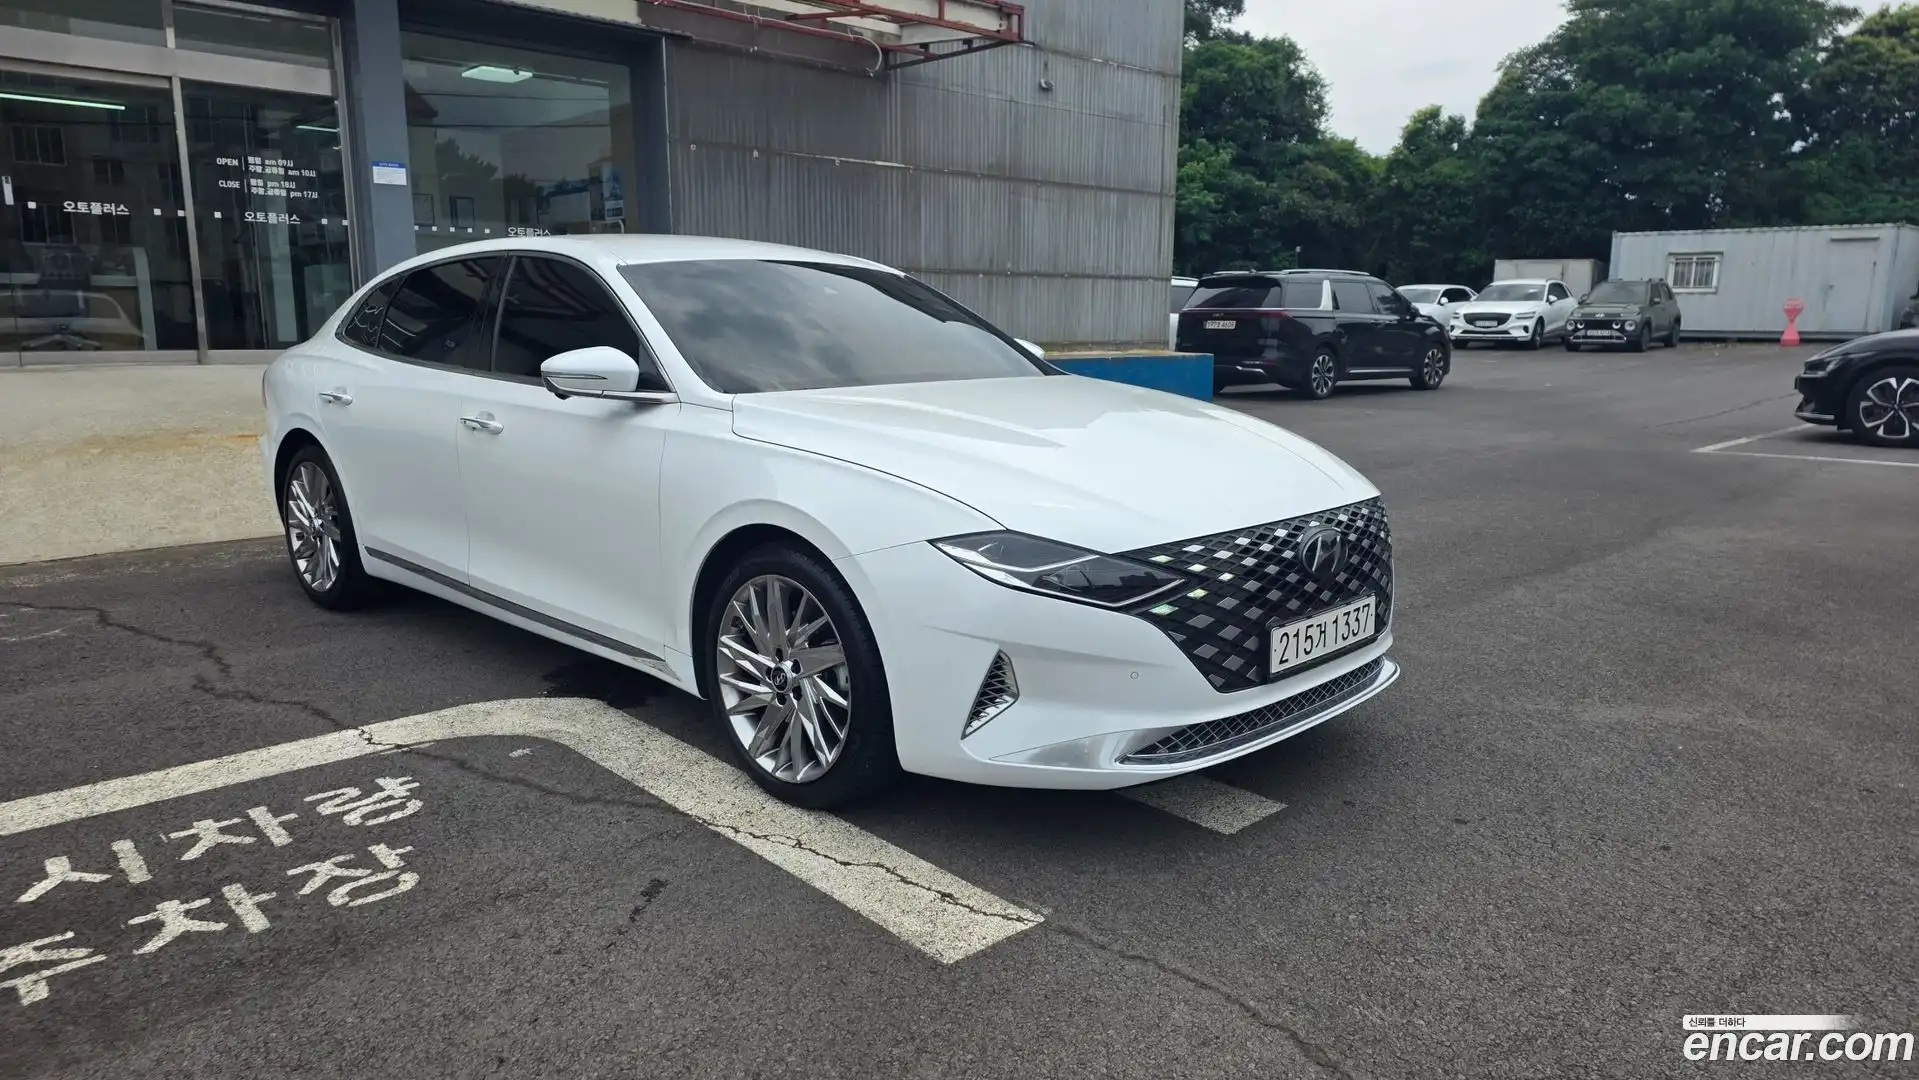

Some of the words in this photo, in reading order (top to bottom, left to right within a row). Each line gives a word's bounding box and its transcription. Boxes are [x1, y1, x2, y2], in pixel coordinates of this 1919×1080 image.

[216, 158, 238, 166] OPEN
[218, 180, 240, 188] CLOSE
[303, 191, 318, 199] 17시
[63, 201, 130, 215] 오토플러스
[244, 211, 301, 224] 오토플러스
[1279, 621, 1327, 665] 215거
[1332, 603, 1371, 645] 1337
[0, 842, 420, 1005] 주차장
